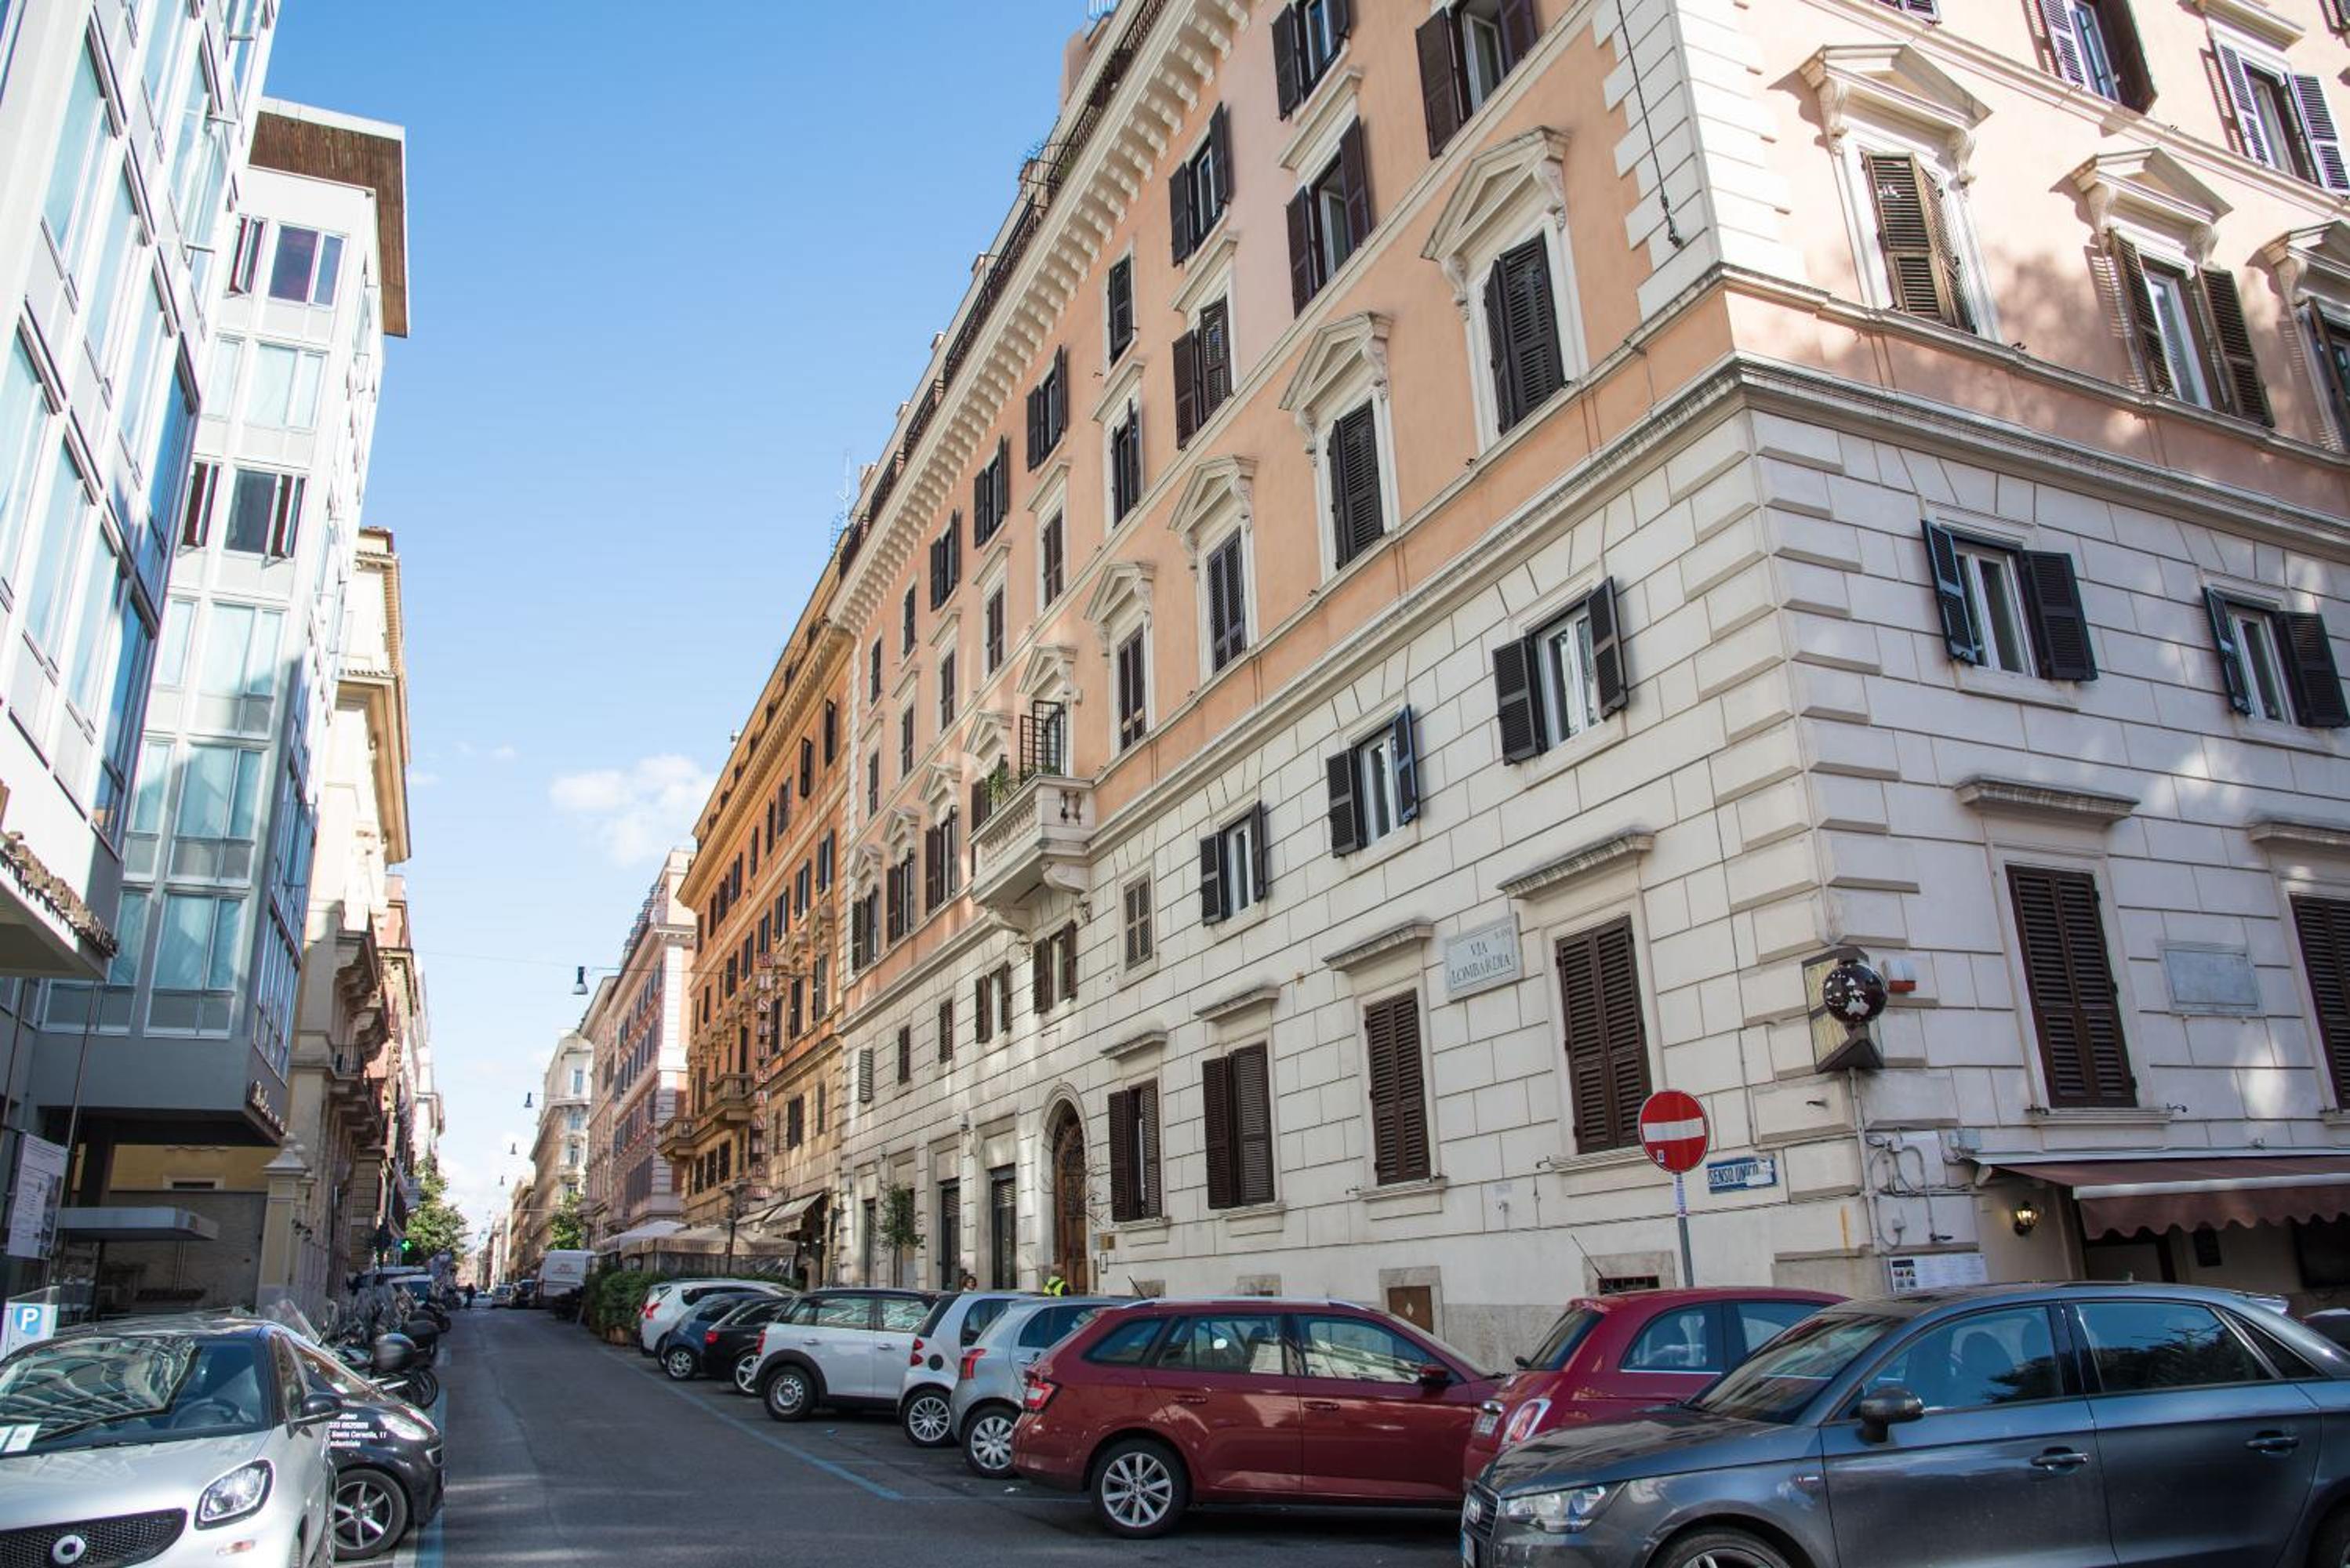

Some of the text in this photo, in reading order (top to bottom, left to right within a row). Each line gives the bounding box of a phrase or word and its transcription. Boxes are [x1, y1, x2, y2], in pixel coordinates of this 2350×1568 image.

[1470, 942, 1487, 956] VIA
[1451, 953, 1512, 984] LOMBARDIA
[21, 1307, 39, 1330] P
